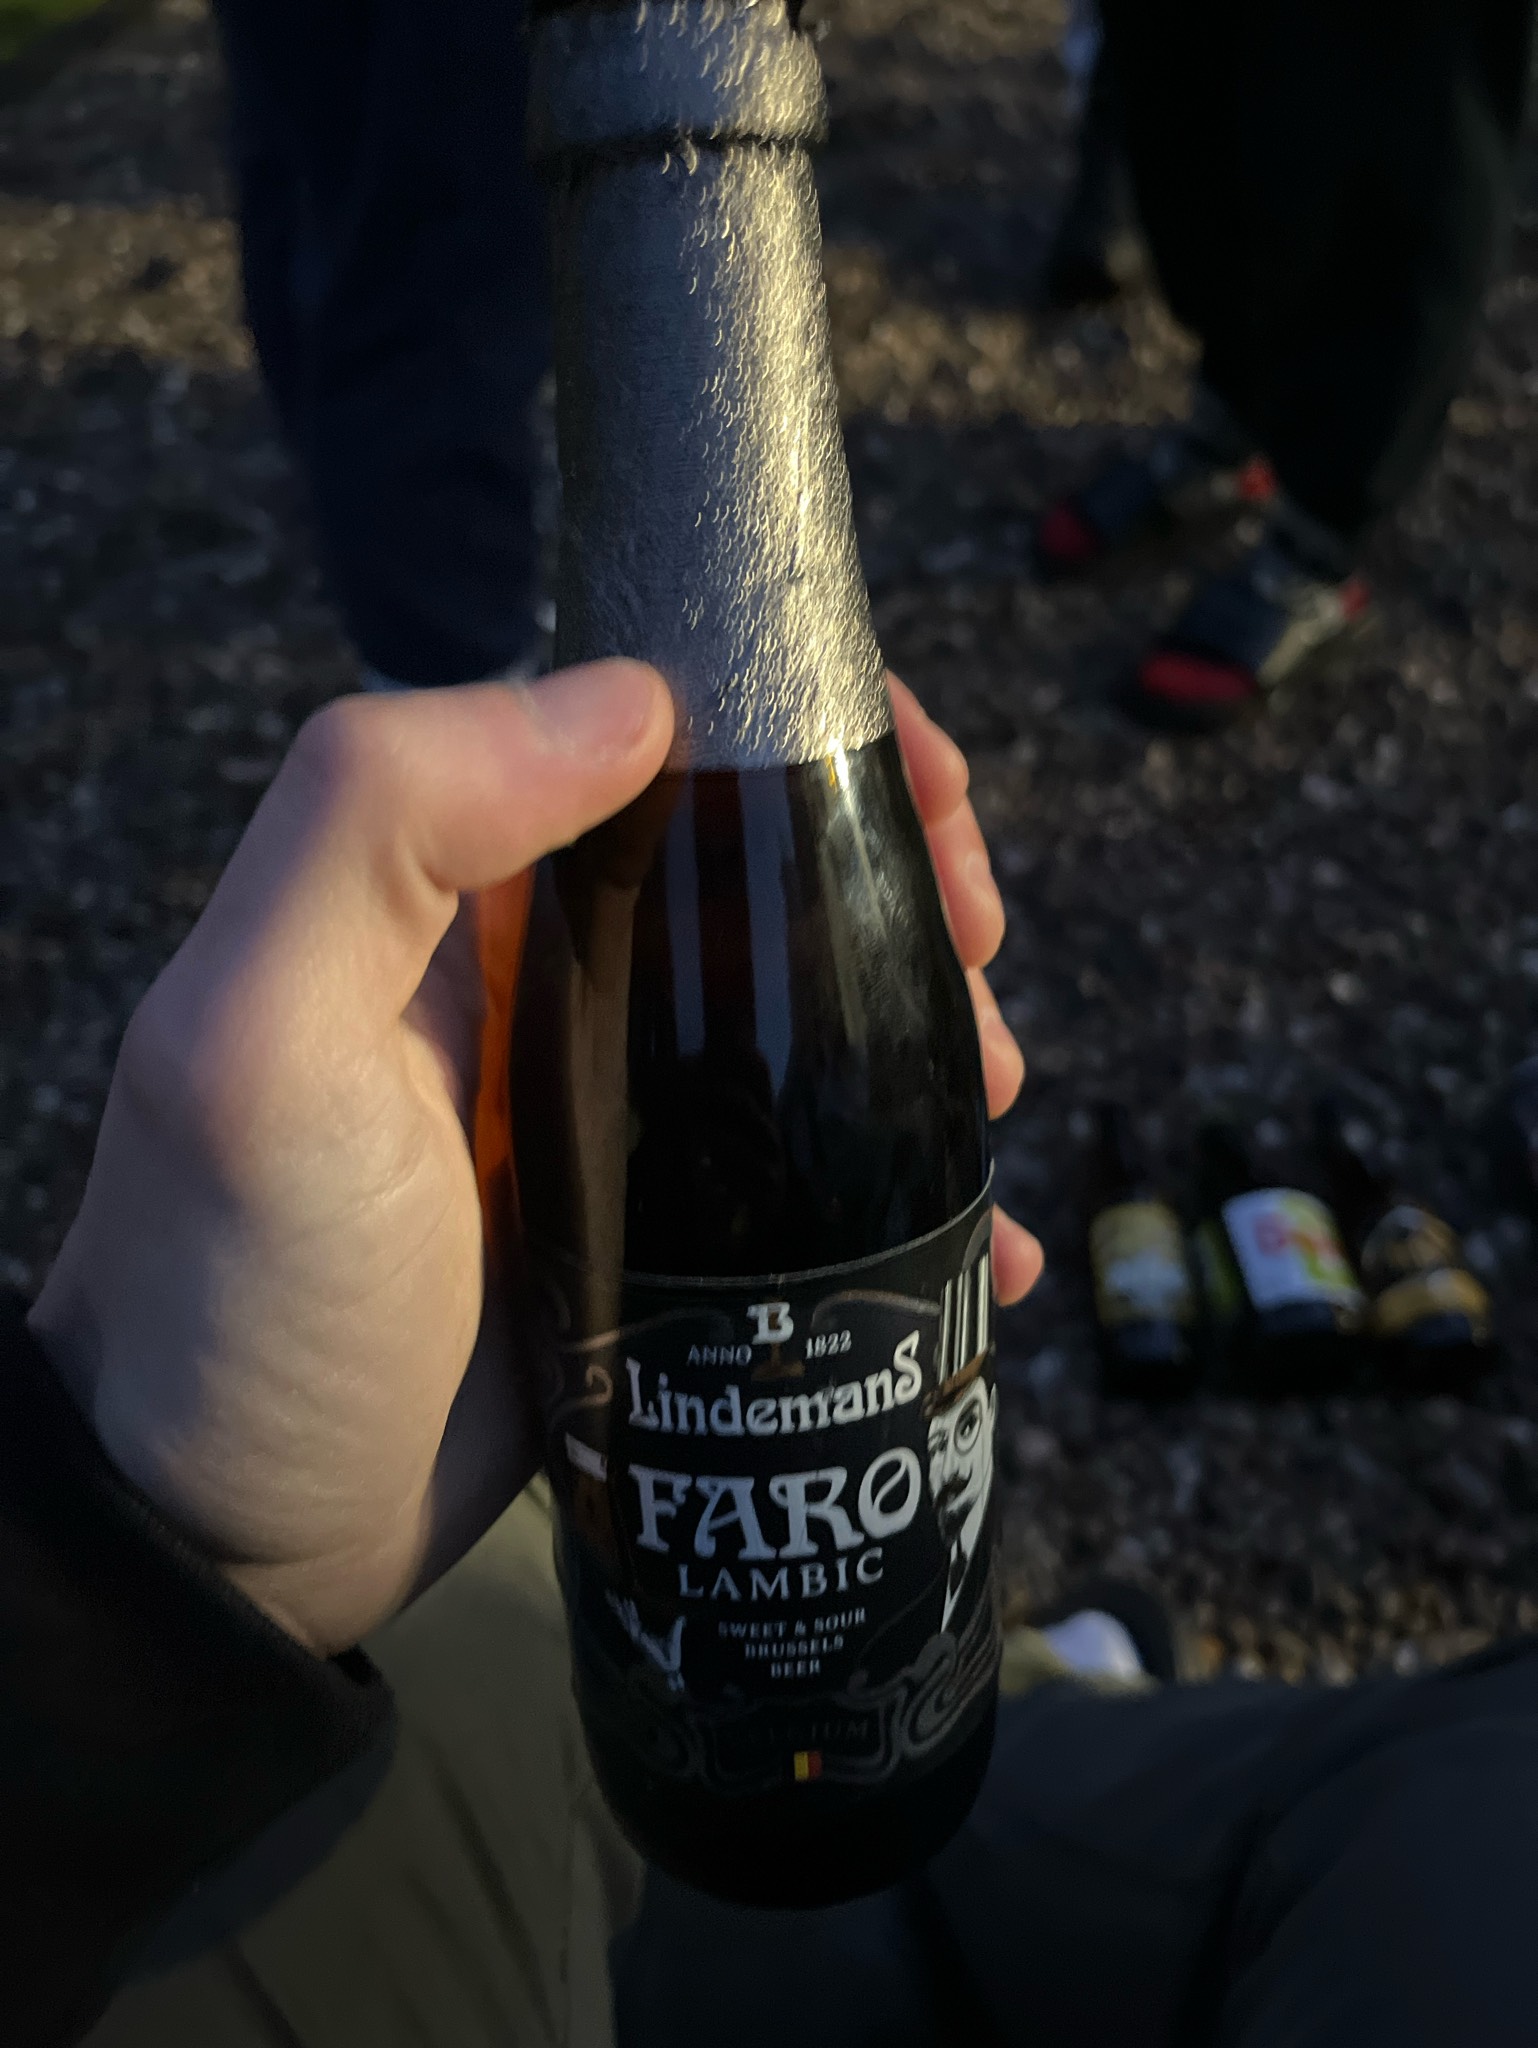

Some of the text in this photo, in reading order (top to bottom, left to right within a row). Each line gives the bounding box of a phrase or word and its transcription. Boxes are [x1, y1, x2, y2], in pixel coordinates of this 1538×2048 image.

[687, 1330, 851, 1367] ANNO 1822
[628, 1446, 922, 1562] FARO
[677, 1547, 884, 1601] LAMBIC
[718, 1606, 866, 1639] SWEET & SOUR
[744, 1634, 844, 1660] BRUSSELS
[770, 1659, 821, 1679] BEER
